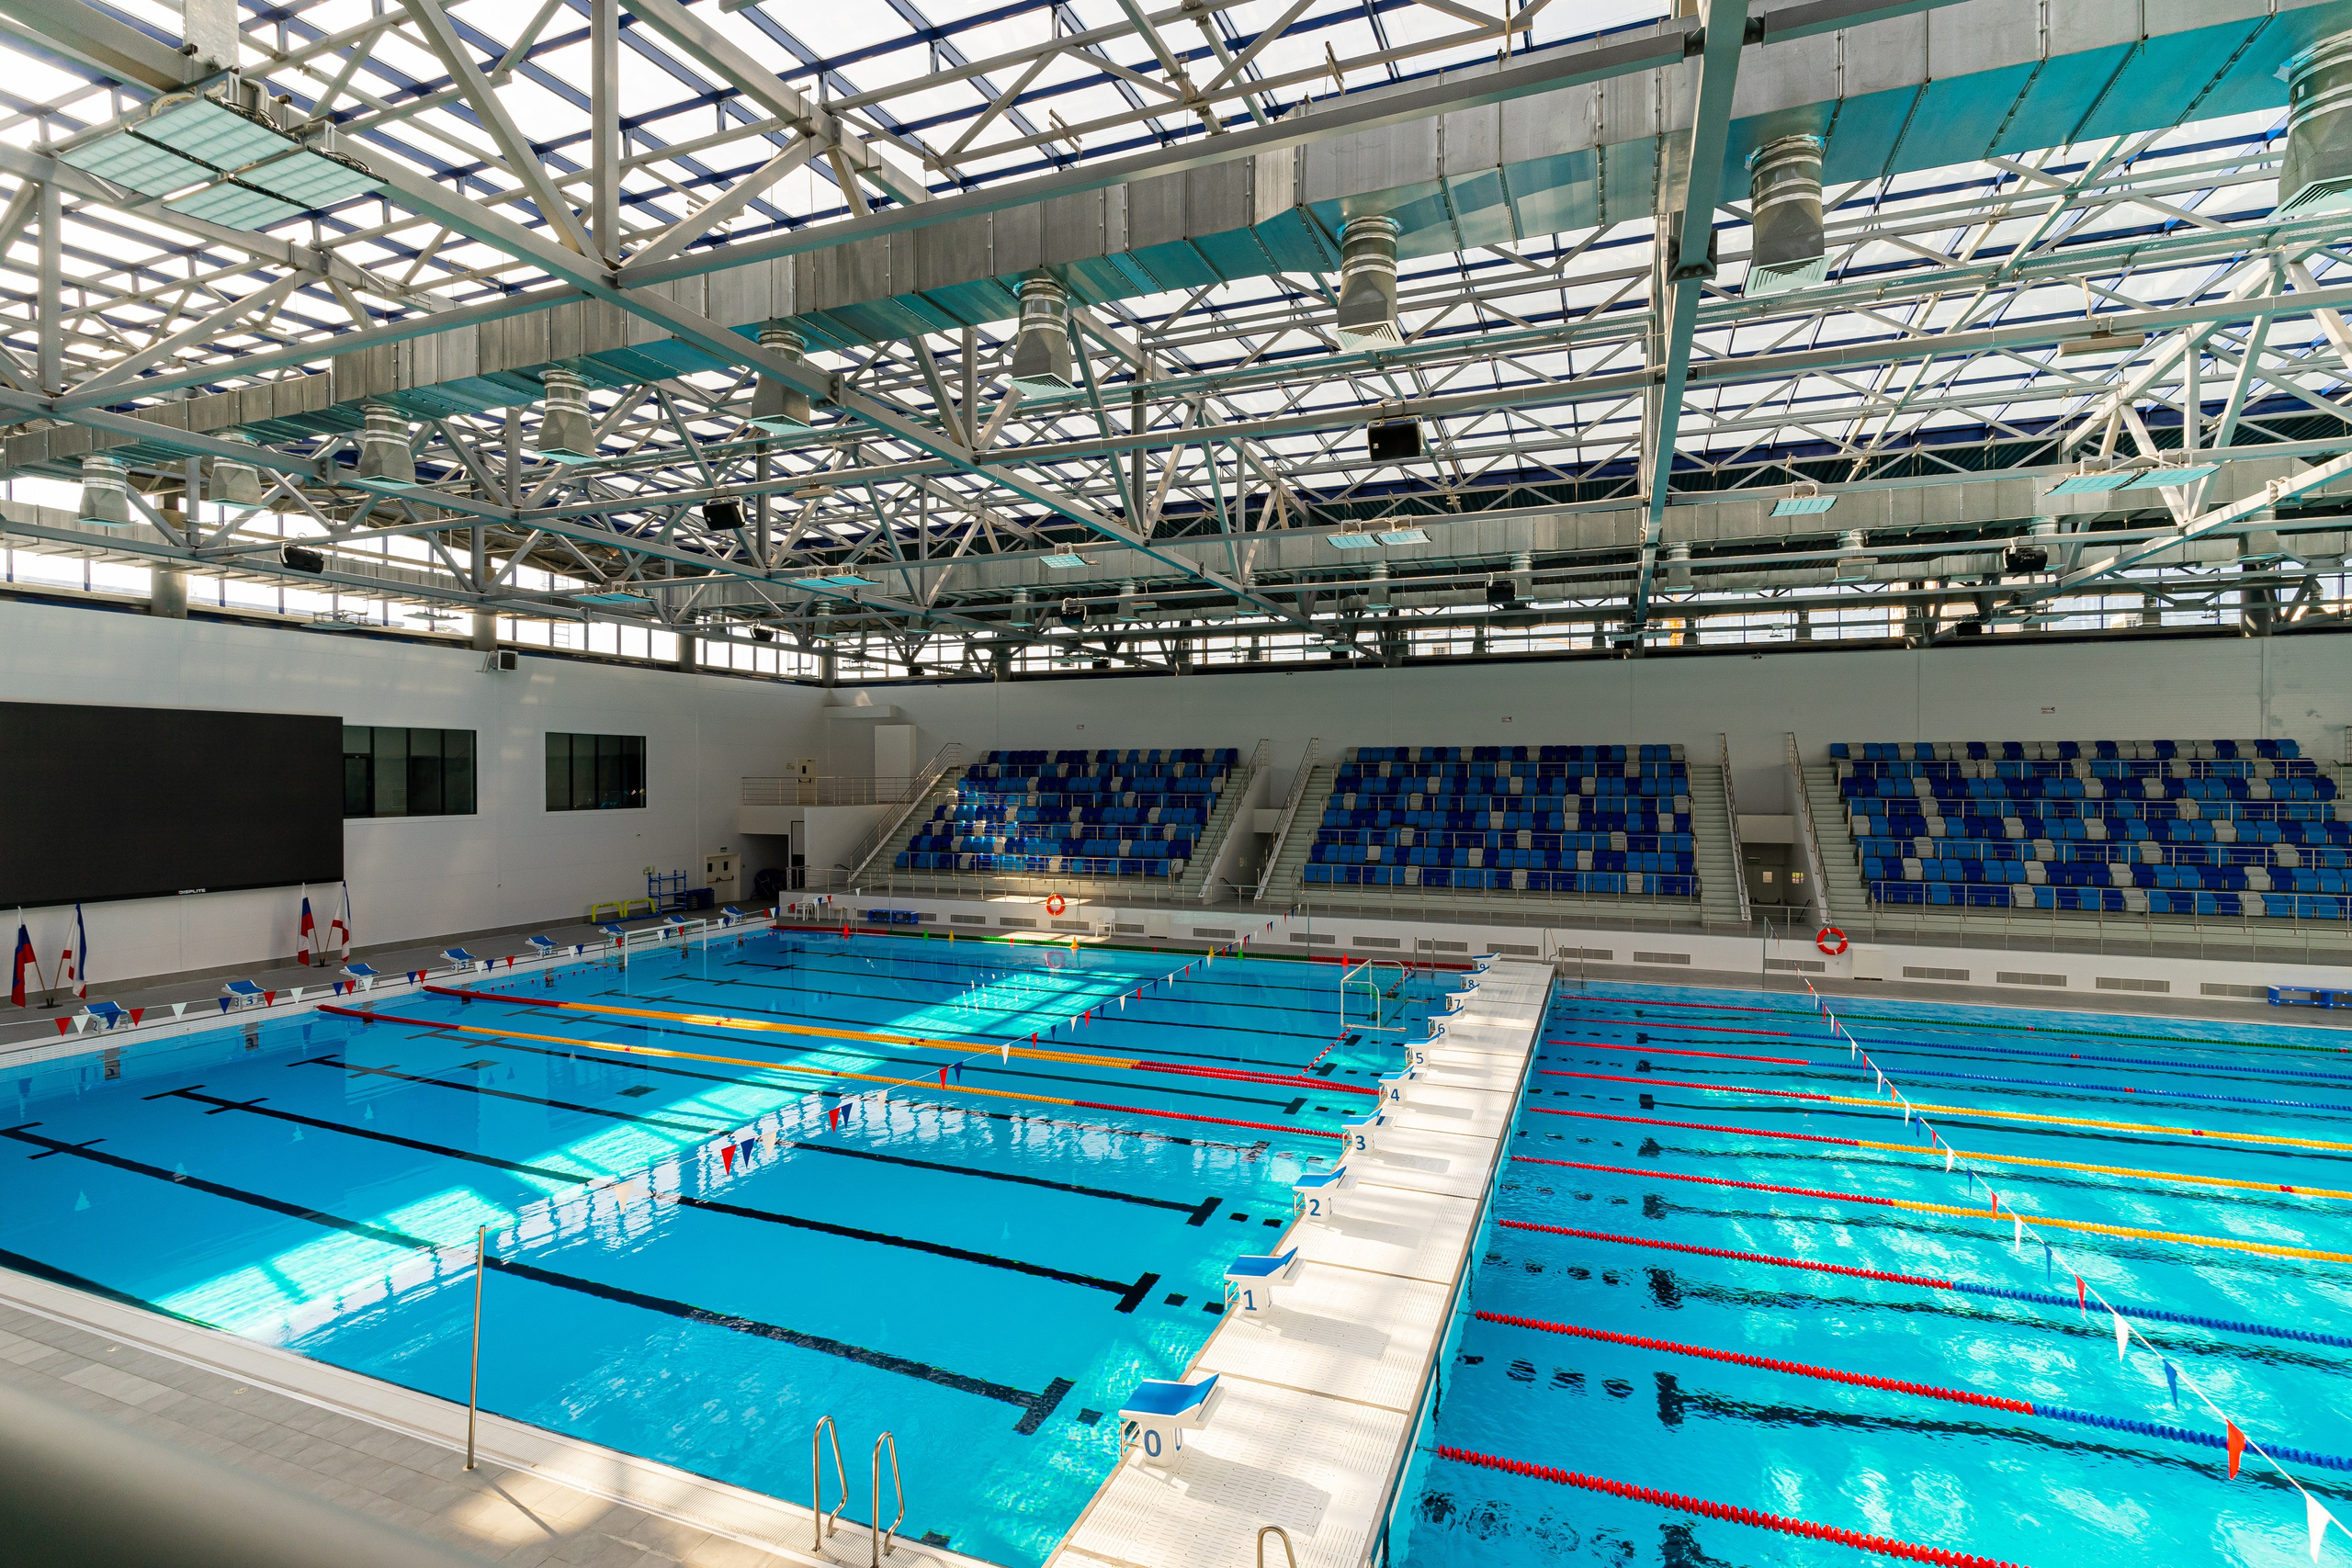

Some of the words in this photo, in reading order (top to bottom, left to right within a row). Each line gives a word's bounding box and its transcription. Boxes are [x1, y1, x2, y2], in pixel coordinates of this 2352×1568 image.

[1467, 979, 1476, 989] 8
[1453, 998, 1461, 1009] 7
[1437, 1022, 1446, 1034] 6
[1416, 1052, 1424, 1065] 5
[1390, 1088, 1400, 1101] 4
[1355, 1134, 1366, 1151] 3
[1309, 1198, 1321, 1216] 2
[1243, 1289, 1258, 1312] 1
[1144, 1429, 1162, 1458] 0
